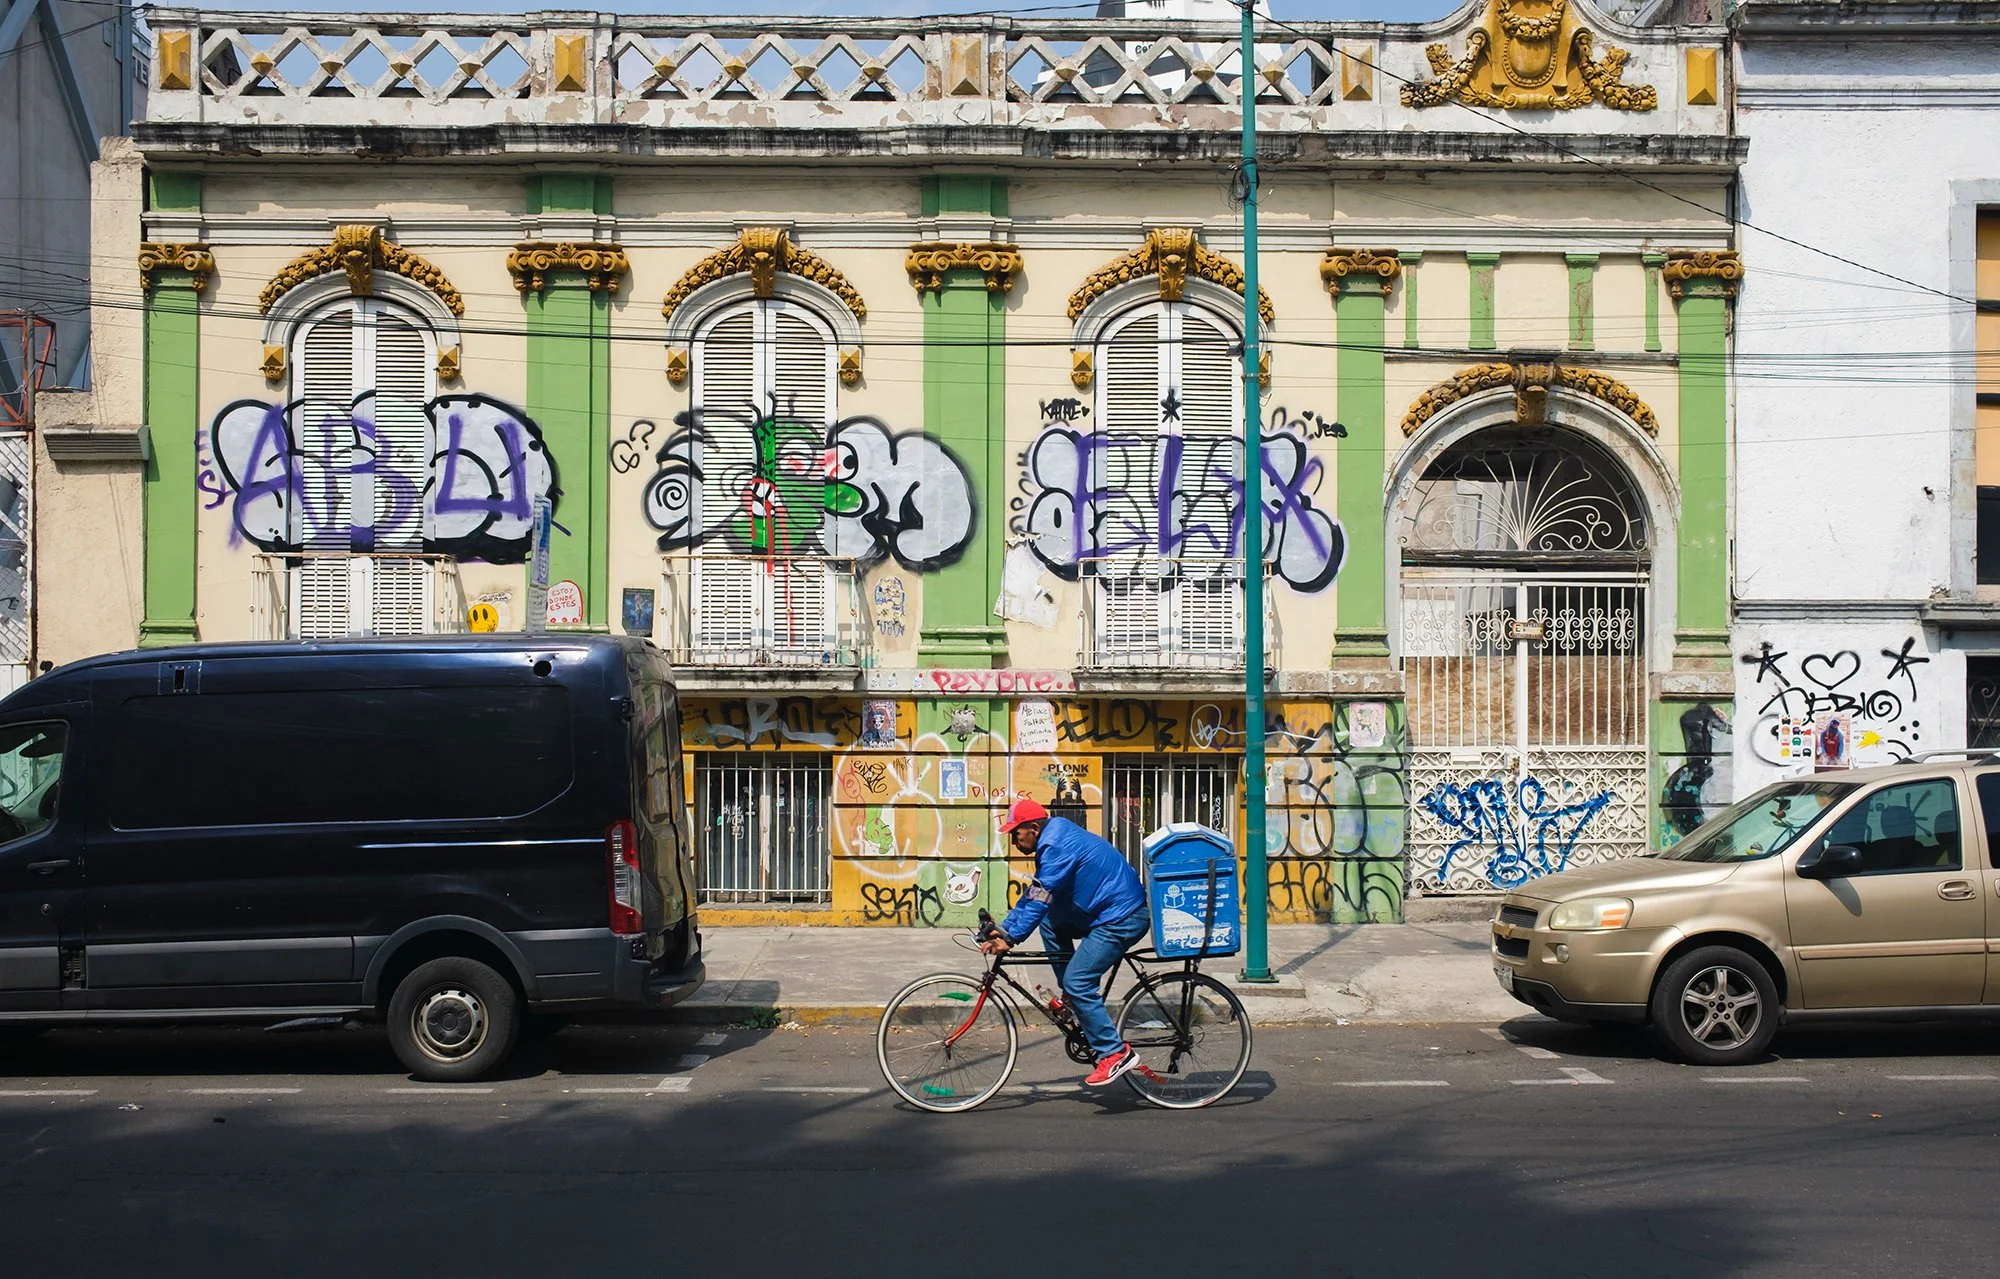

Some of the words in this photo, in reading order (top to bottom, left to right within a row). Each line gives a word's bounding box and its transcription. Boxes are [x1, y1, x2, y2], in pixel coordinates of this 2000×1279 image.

[552, 588, 573, 596] ESTOY
[549, 594, 573, 604] DONDE
[550, 599, 576, 611] ESTES
[1047, 763, 1089, 773] PLONK
